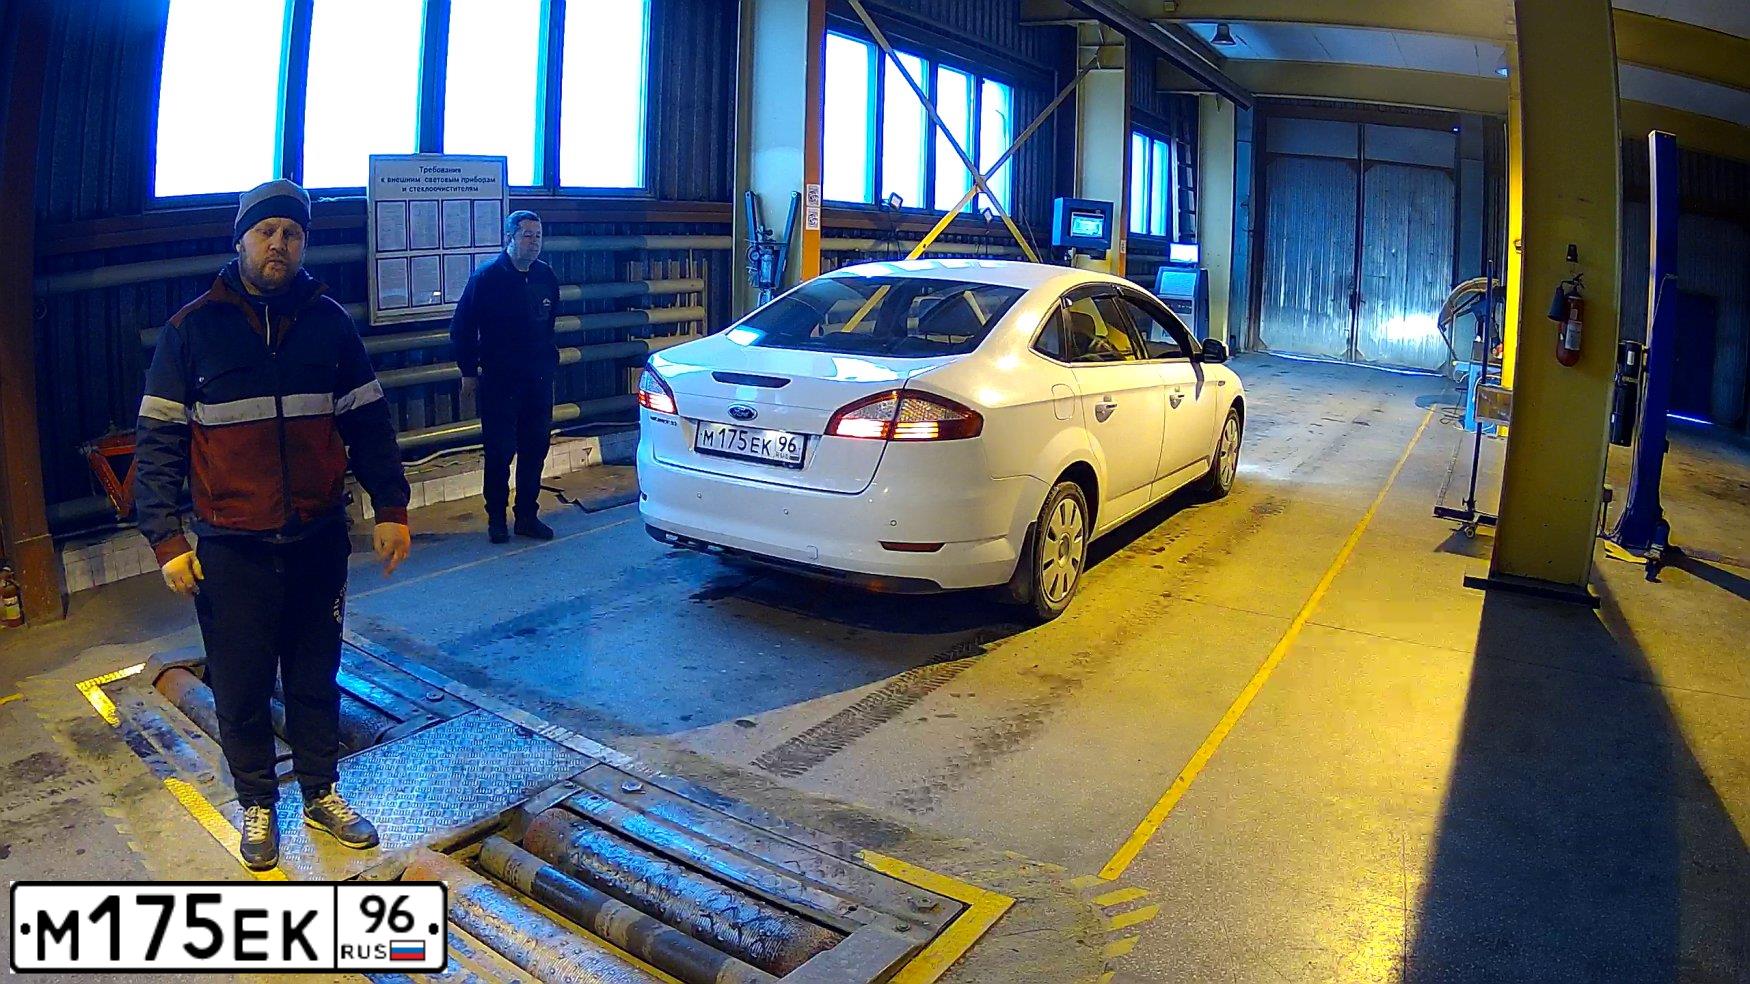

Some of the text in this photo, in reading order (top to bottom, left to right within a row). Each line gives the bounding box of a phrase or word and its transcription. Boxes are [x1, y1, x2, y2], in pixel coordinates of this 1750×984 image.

[419, 166, 462, 174] Требования
[461, 176, 496, 184] приборам
[778, 436, 797, 453] 96
